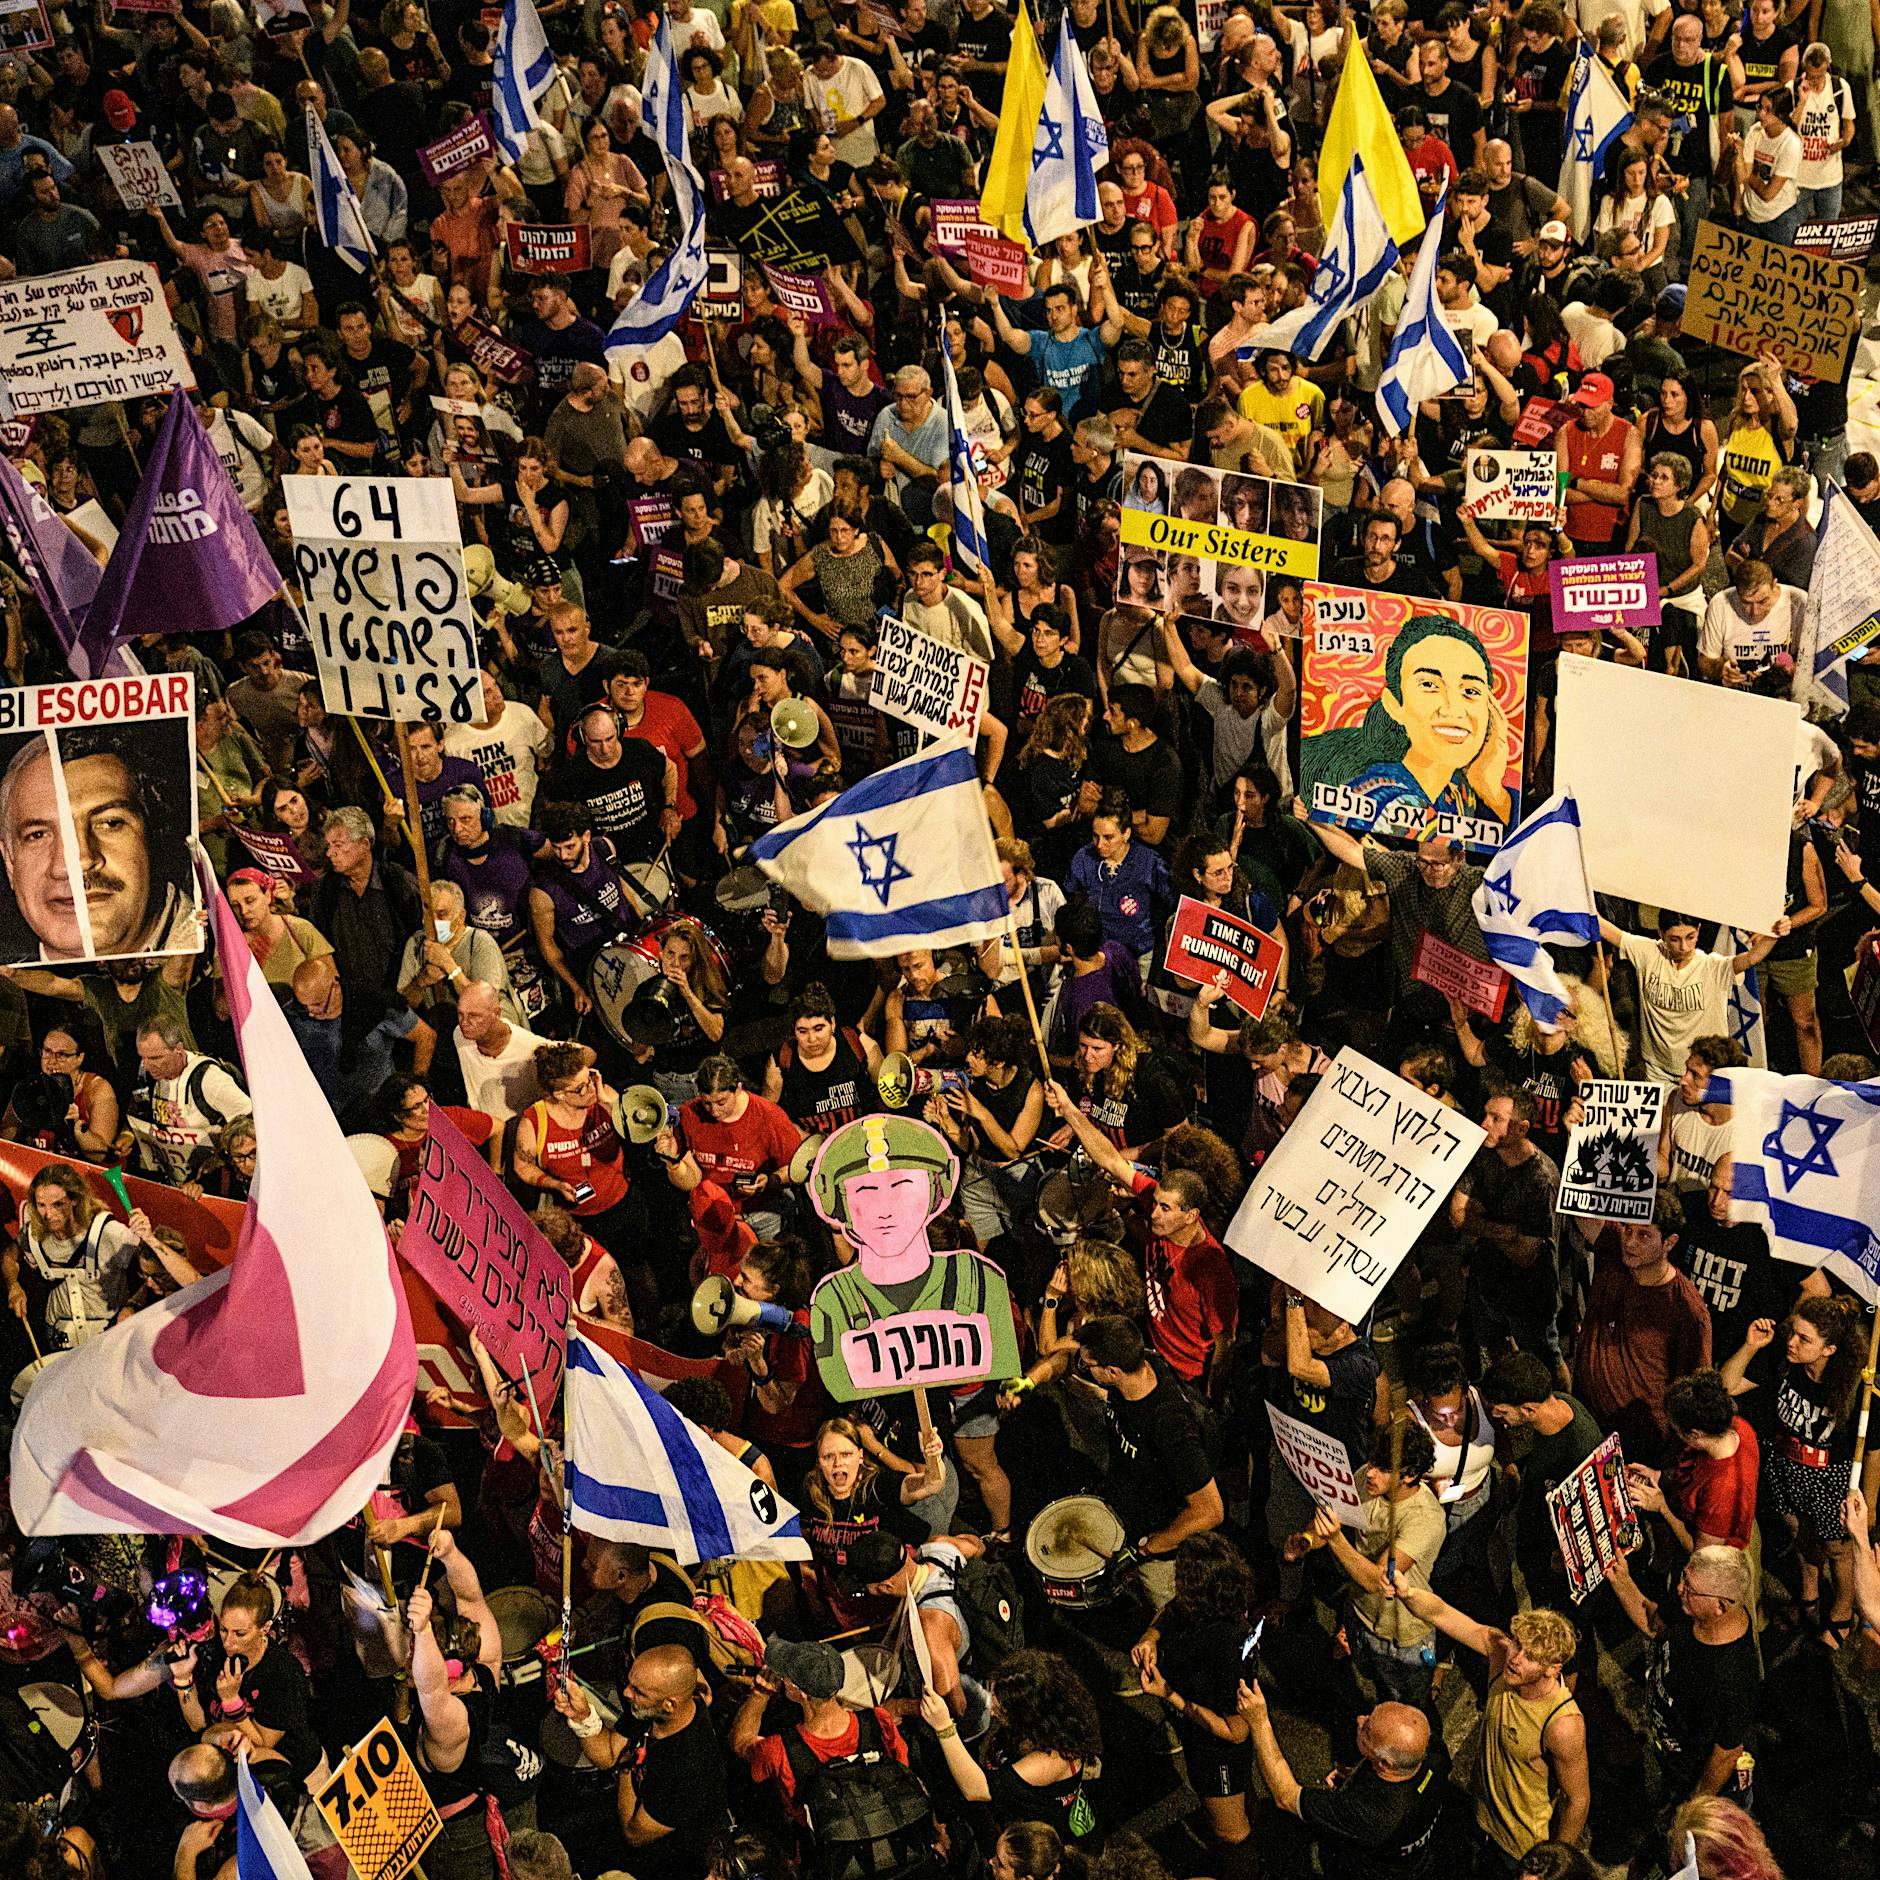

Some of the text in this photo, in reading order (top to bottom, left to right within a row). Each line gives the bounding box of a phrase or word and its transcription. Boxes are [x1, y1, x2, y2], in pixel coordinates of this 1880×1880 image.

[434, 139, 486, 169] עכשיו
[549, 230, 577, 244] נגמר
[1797, 218, 1878, 238] הפסקת אש
[1002, 247, 1024, 263] קול
[1706, 232, 1751, 261] את
[991, 262, 1018, 280] זועק
[1692, 254, 1744, 284] שלכם
[1761, 244, 1859, 292] תאהבו
[25, 285, 45, 303] של
[67, 297, 85, 313] של
[1703, 282, 1847, 338] כמו שאתם
[1706, 306, 1840, 360] אוהבים את
[1512, 486, 1553, 498] ישראל
[333, 483, 402, 538] 64
[1150, 518, 1288, 568] Our Sisters
[1561, 559, 1645, 577] לקבל את העסקה
[1562, 571, 1645, 585] לעצור את המלחמה
[1318, 601, 1366, 622] נועה
[1569, 588, 1641, 607] עכשיו
[319, 612, 476, 668] השתלטו
[882, 620, 918, 654] עכשיו
[1318, 633, 1374, 654] בבית!
[1839, 620, 1877, 649] הופקרנו
[918, 638, 964, 677] לעסקה
[340, 666, 478, 722] עלינו
[907, 665, 959, 701] לבחירות
[0, 677, 189, 728] BI ESCOBAR
[472, 741, 507, 765] אתה
[587, 782, 643, 808] אין דמוקרטיה
[606, 791, 645, 813] עם כיבוש
[1314, 784, 1501, 846] רוצים את כולם!
[1211, 919, 1255, 955] TIME IS
[1180, 933, 1268, 990] RUNNING OUT!
[1580, 1082, 1661, 1106] מי שהרס
[1330, 1062, 1461, 1162] הלחץ הצבאי
[1622, 1106, 1657, 1129] לא
[1320, 1122, 1436, 1210] הורג חטופים
[1563, 1188, 1650, 1217] בחירות עכשיו!
[424, 1135, 569, 1330] לא מפקירים
[1260, 1186, 1387, 1287] עסקה עכשיו
[416, 1188, 564, 1383] חיילים בשטח
[853, 1324, 981, 1373] הופקר
[1277, 1433, 1354, 1486] עסקה
[1570, 1499, 1585, 1529] FOR
[1581, 1464, 1607, 1534] KIDNAPPED
[1575, 1524, 1595, 1569] SORRY
[319, 1730, 400, 1830] 7.10
[405, 1812, 437, 1857] בחירות
